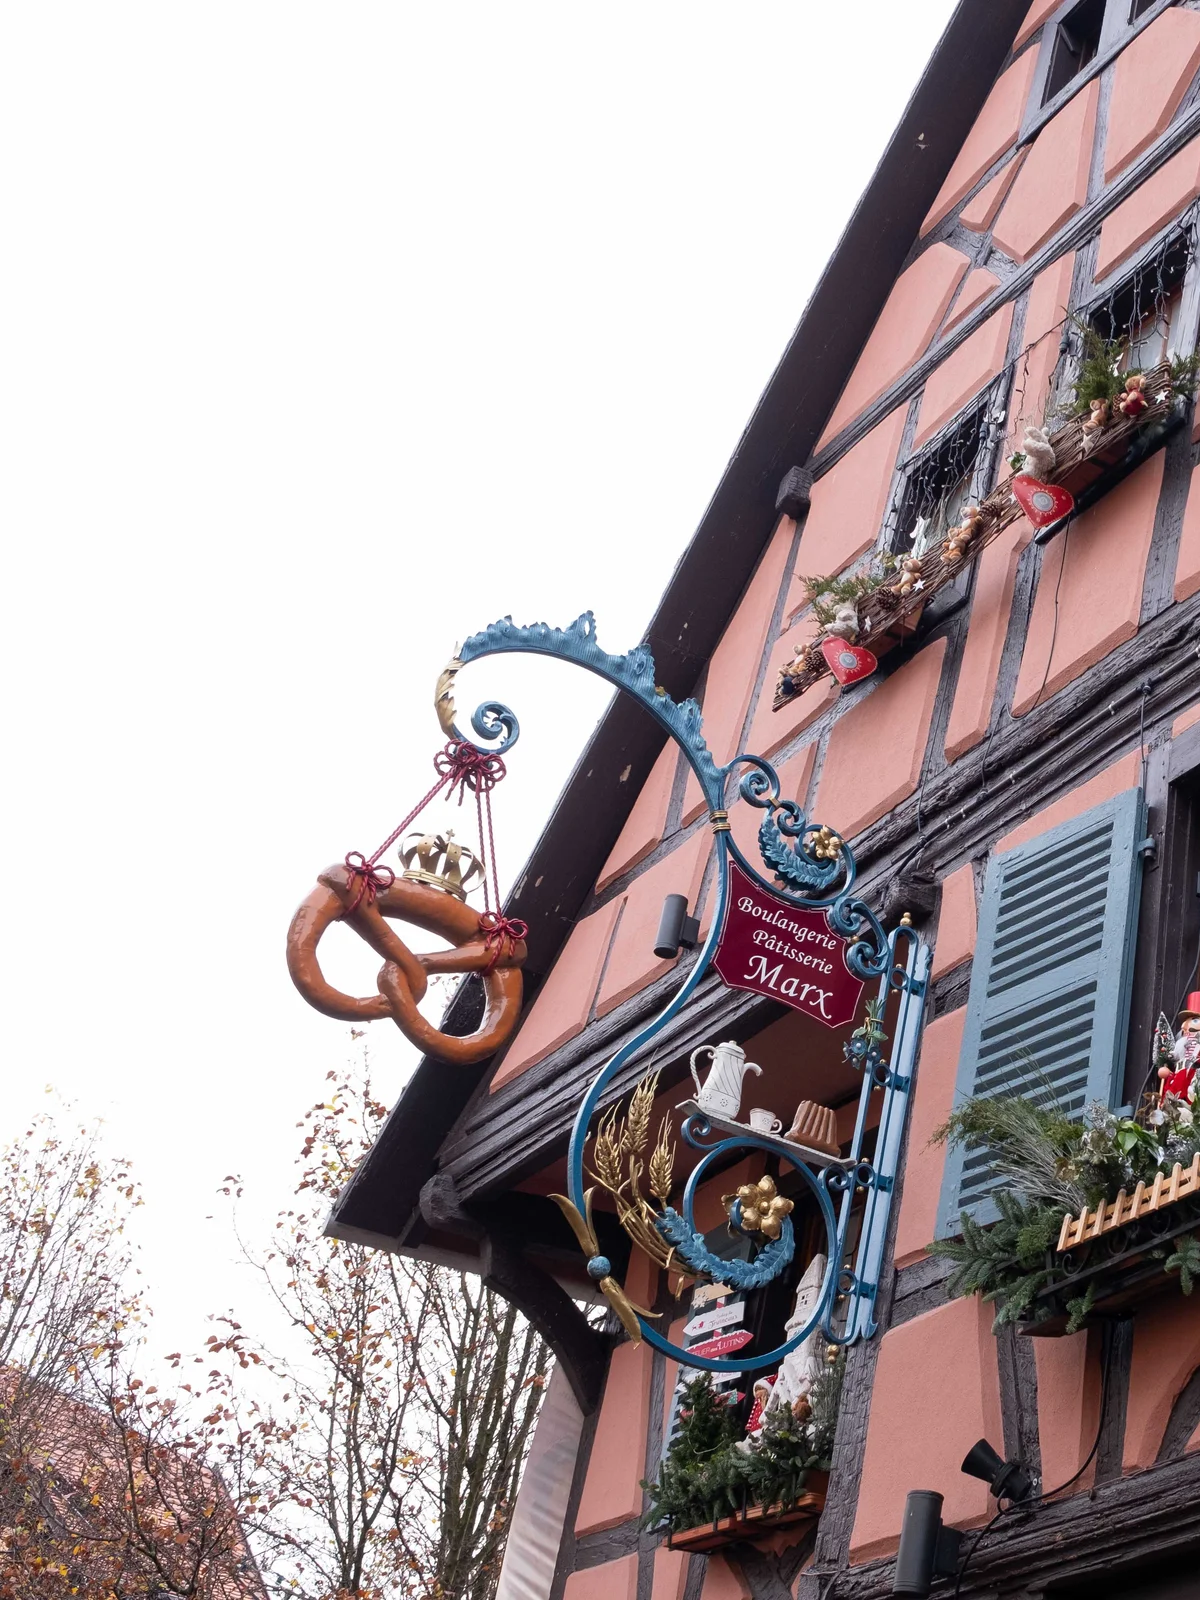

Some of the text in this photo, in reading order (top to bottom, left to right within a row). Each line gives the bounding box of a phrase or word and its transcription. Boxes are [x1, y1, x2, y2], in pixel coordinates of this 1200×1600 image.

[737, 896, 837, 950] Boulangerie
[752, 929, 833, 974] Pâtisserie
[743, 955, 833, 1019] Marx
